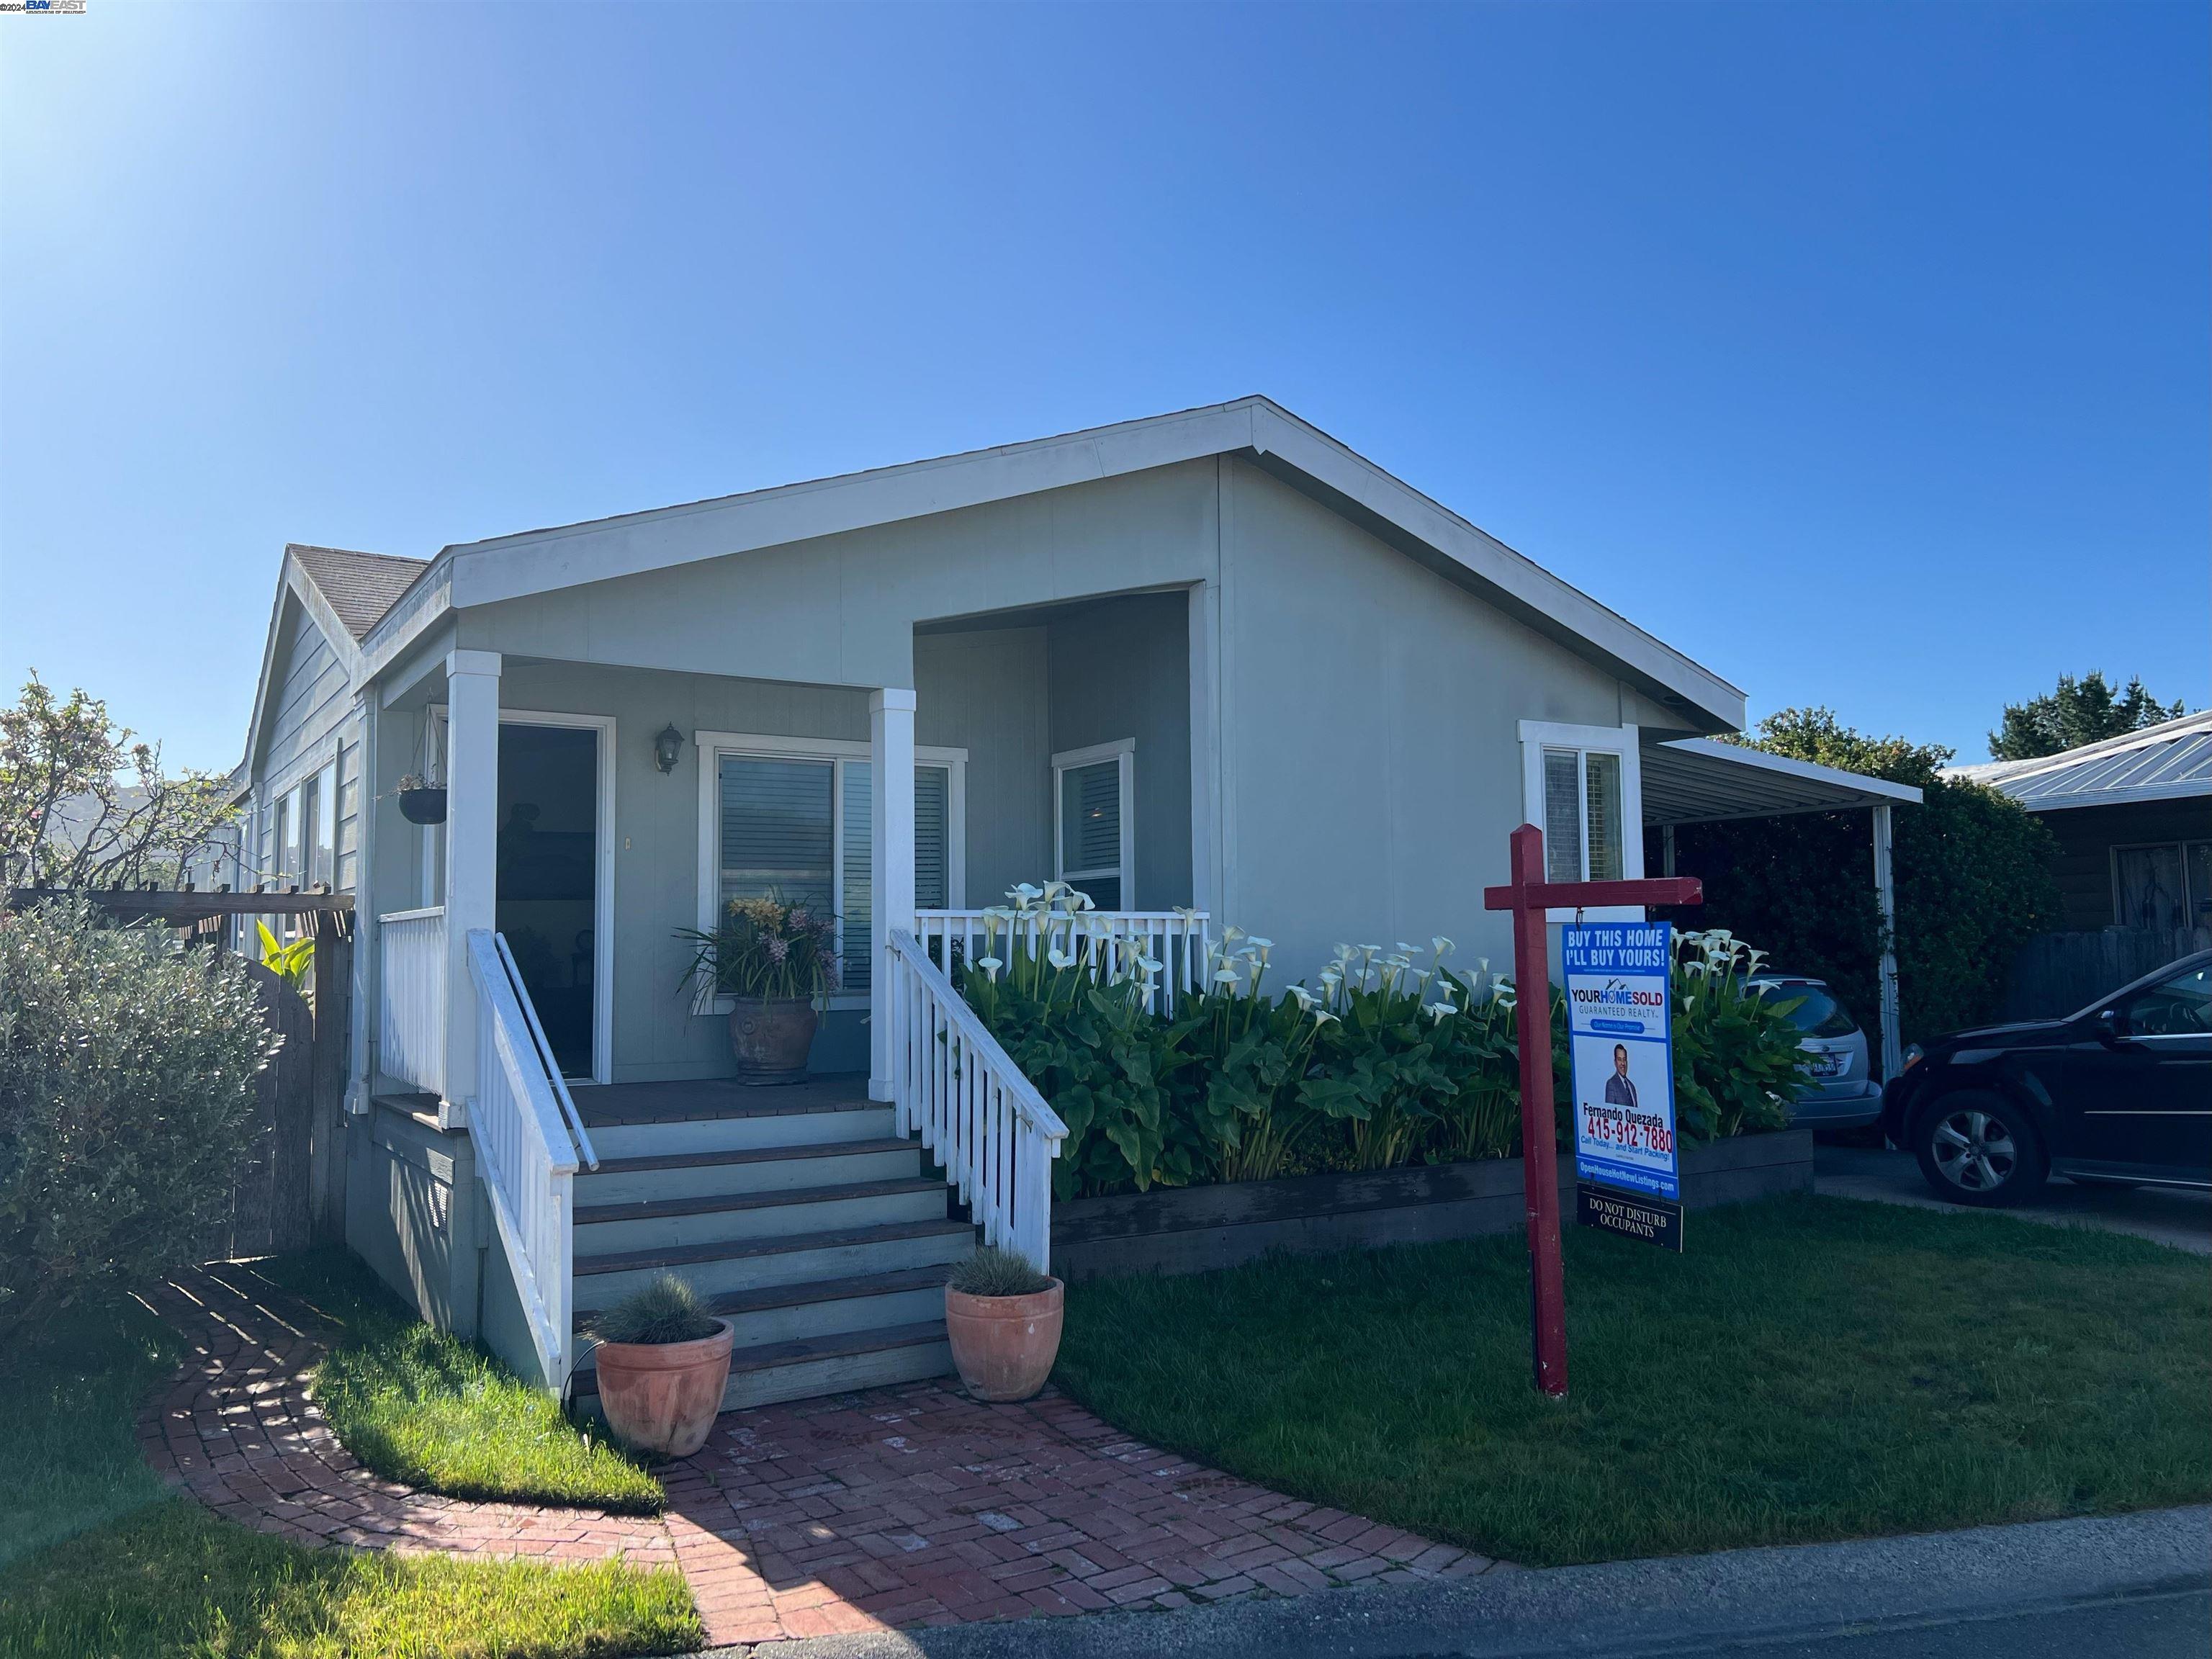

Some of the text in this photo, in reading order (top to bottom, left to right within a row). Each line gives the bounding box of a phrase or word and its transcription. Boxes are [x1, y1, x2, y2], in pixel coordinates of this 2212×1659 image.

[1568, 929, 1663, 948] BUY THIS HOME
[1566, 949, 1665, 966] I'LL BUY YOURS!
[1578, 1005, 1626, 1017] GUARANTEED
[1583, 1102, 1663, 1128] Fernando Quezada
[1581, 1135, 1591, 1145] Call
[1616, 1143, 1627, 1151] and
[1628, 1144, 1643, 1155] Start
[1588, 1116, 1673, 1154] 415-912-7880
[1589, 1197, 1667, 1228] DO NOT DISTURB
[1600, 1213, 1655, 1238] OCCUPANTS
